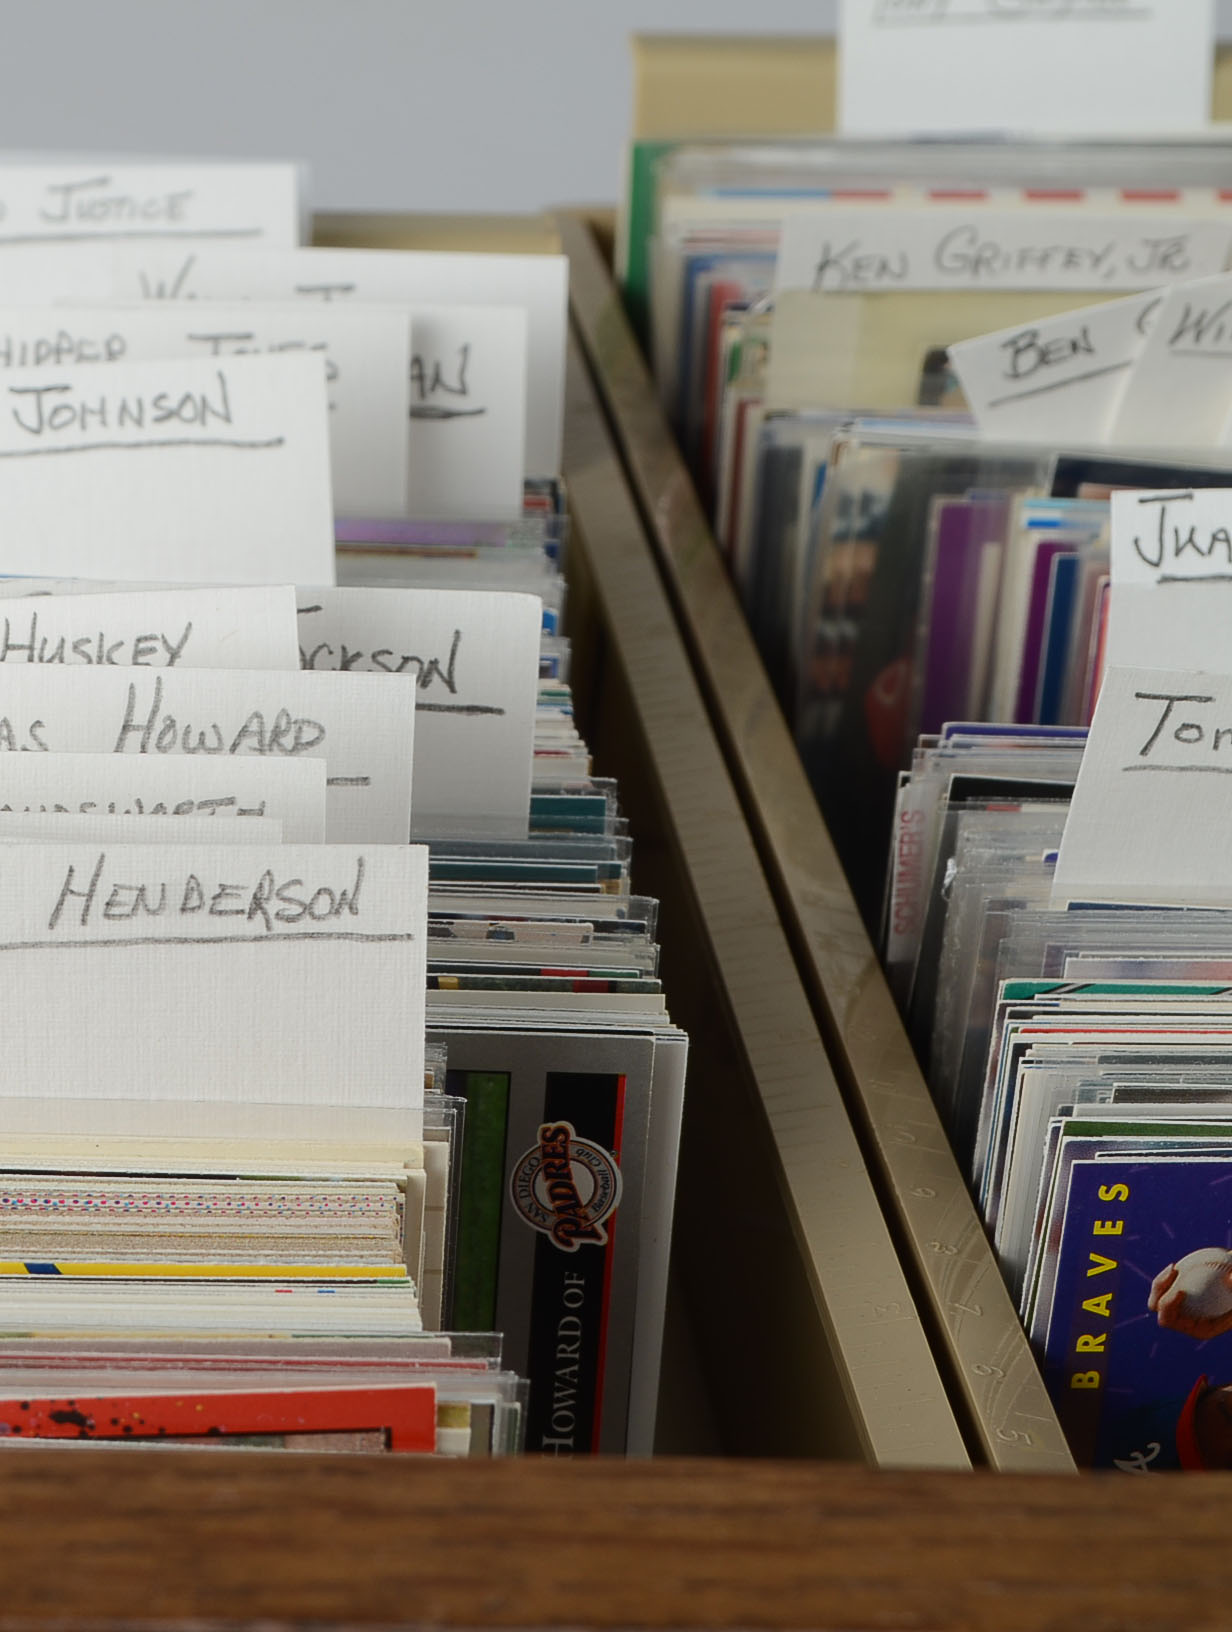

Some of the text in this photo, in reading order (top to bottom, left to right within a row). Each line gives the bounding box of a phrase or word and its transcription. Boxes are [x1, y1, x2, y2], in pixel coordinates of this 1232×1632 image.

[812, 236, 909, 294] KEN
[1001, 325, 1096, 380] BEN
[10, 370, 234, 436] JOHNSON
[113, 676, 328, 754] HOWARD
[48, 853, 364, 931] HENDERSON
[540, 1124, 605, 1248] PADRES
[1071, 1182, 1131, 1390] BRAVES
[542, 1271, 586, 1458] HOWARD OF
